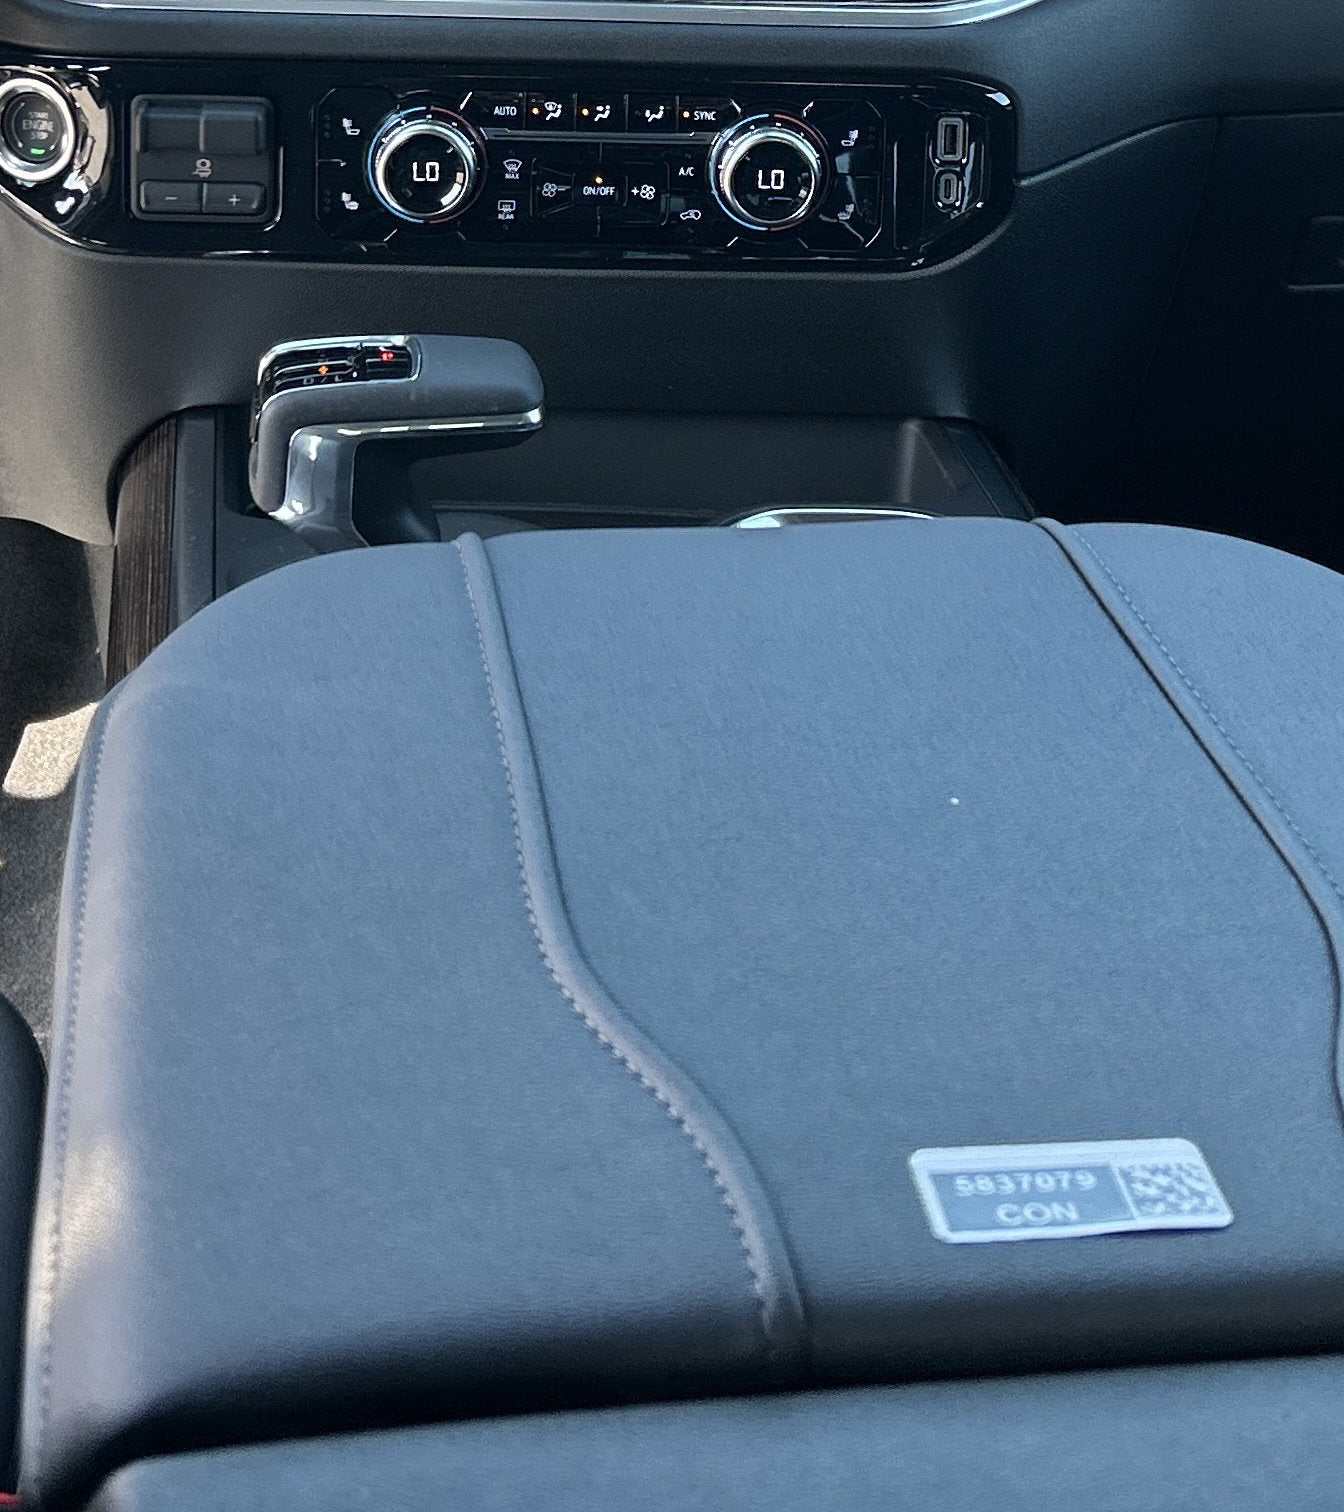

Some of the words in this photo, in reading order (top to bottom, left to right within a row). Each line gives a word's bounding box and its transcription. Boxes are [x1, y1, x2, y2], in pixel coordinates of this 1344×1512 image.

[493, 105, 517, 116] AUTO
[693, 110, 717, 121] SYNC
[678, 167, 695, 177] A/C
[582, 186, 616, 196] ON/OFF
[995, 1200, 1080, 1226] CON
